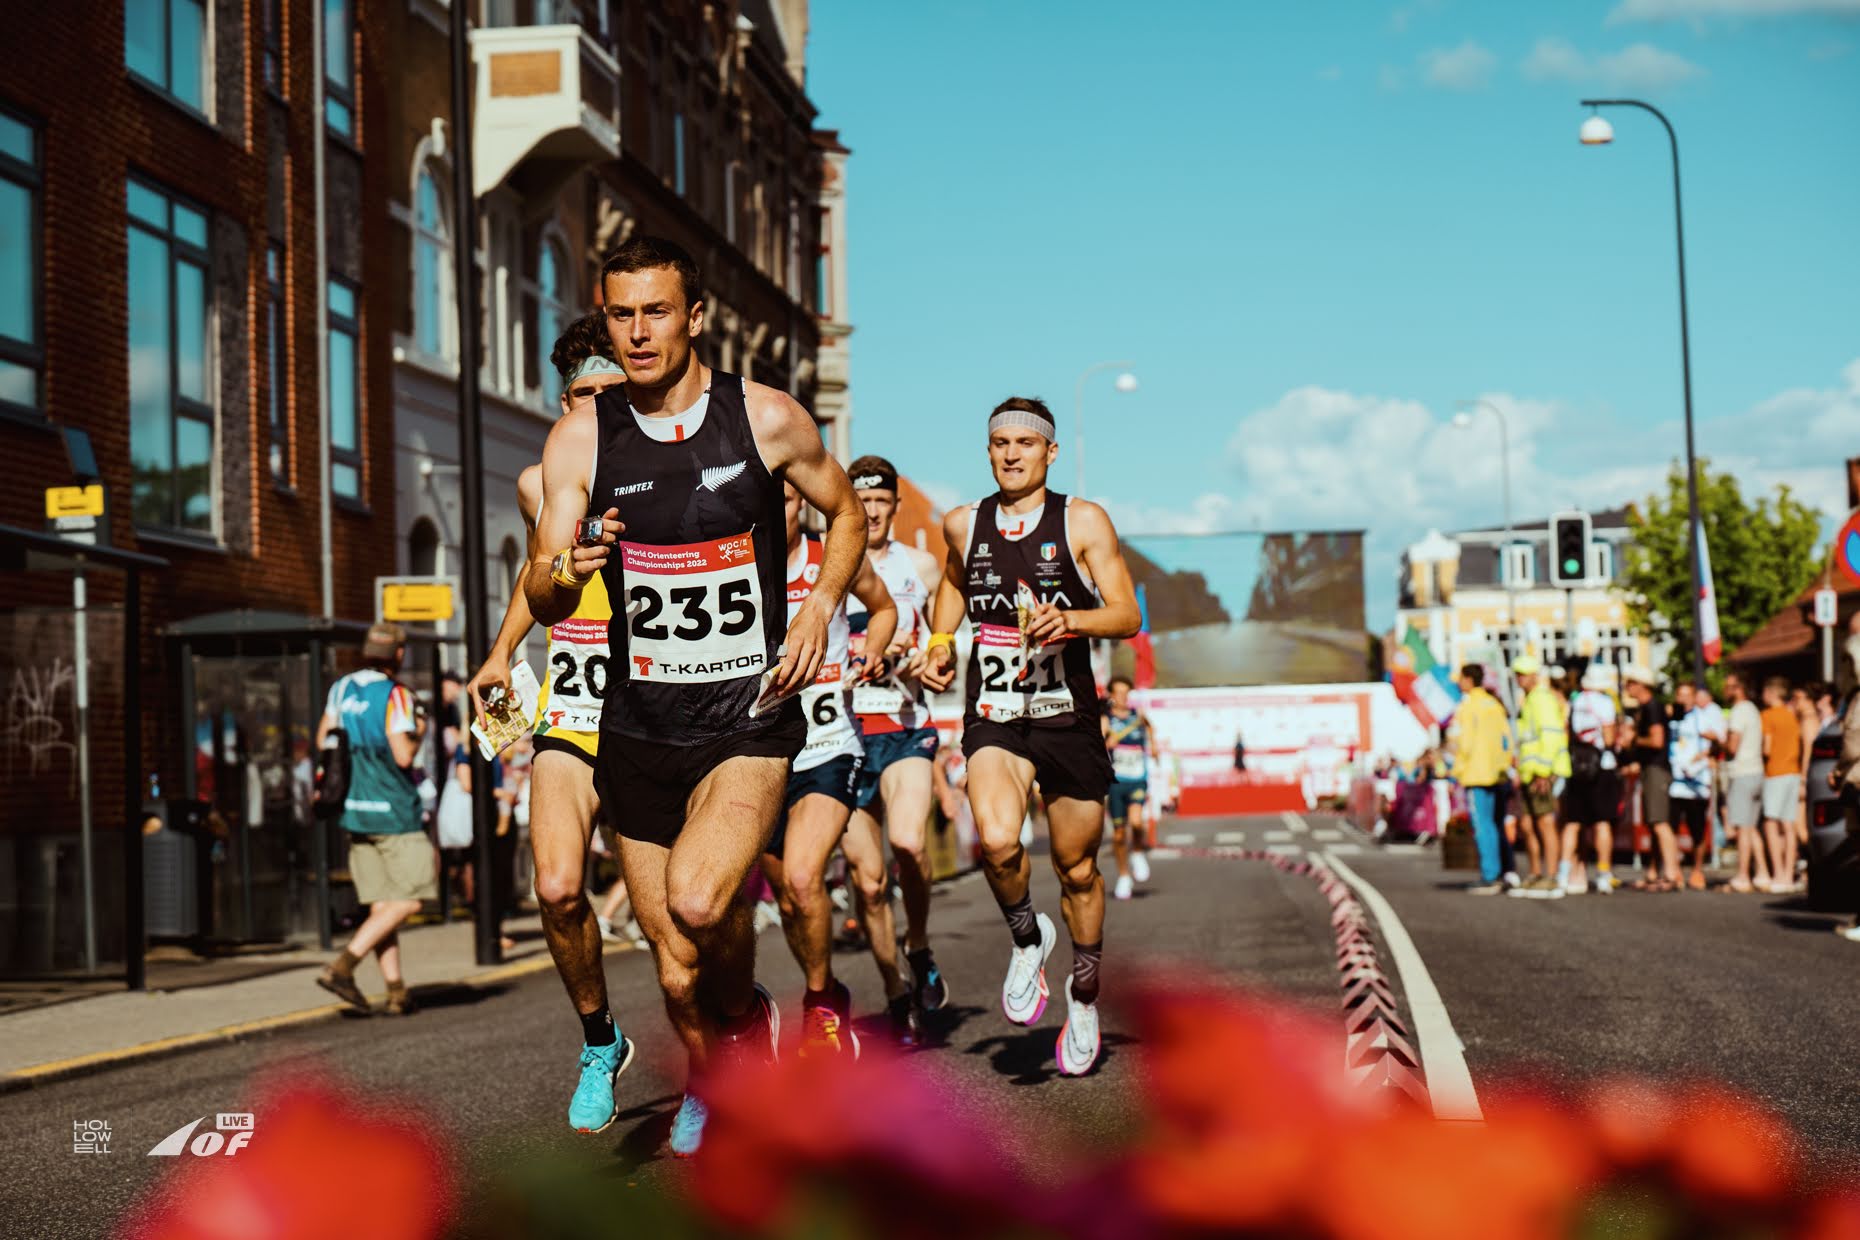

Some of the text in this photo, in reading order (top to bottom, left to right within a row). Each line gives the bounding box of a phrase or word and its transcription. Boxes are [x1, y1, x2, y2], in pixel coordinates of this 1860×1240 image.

[613, 480, 654, 497] TRIMTEX
[626, 547, 700, 560] World Orienteering
[627, 557, 707, 570] Championships 2022
[630, 578, 756, 641] 235
[660, 653, 764, 675] T-KARTOR
[984, 654, 1063, 694] 221
[998, 701, 1071, 719] T-KARTOR
